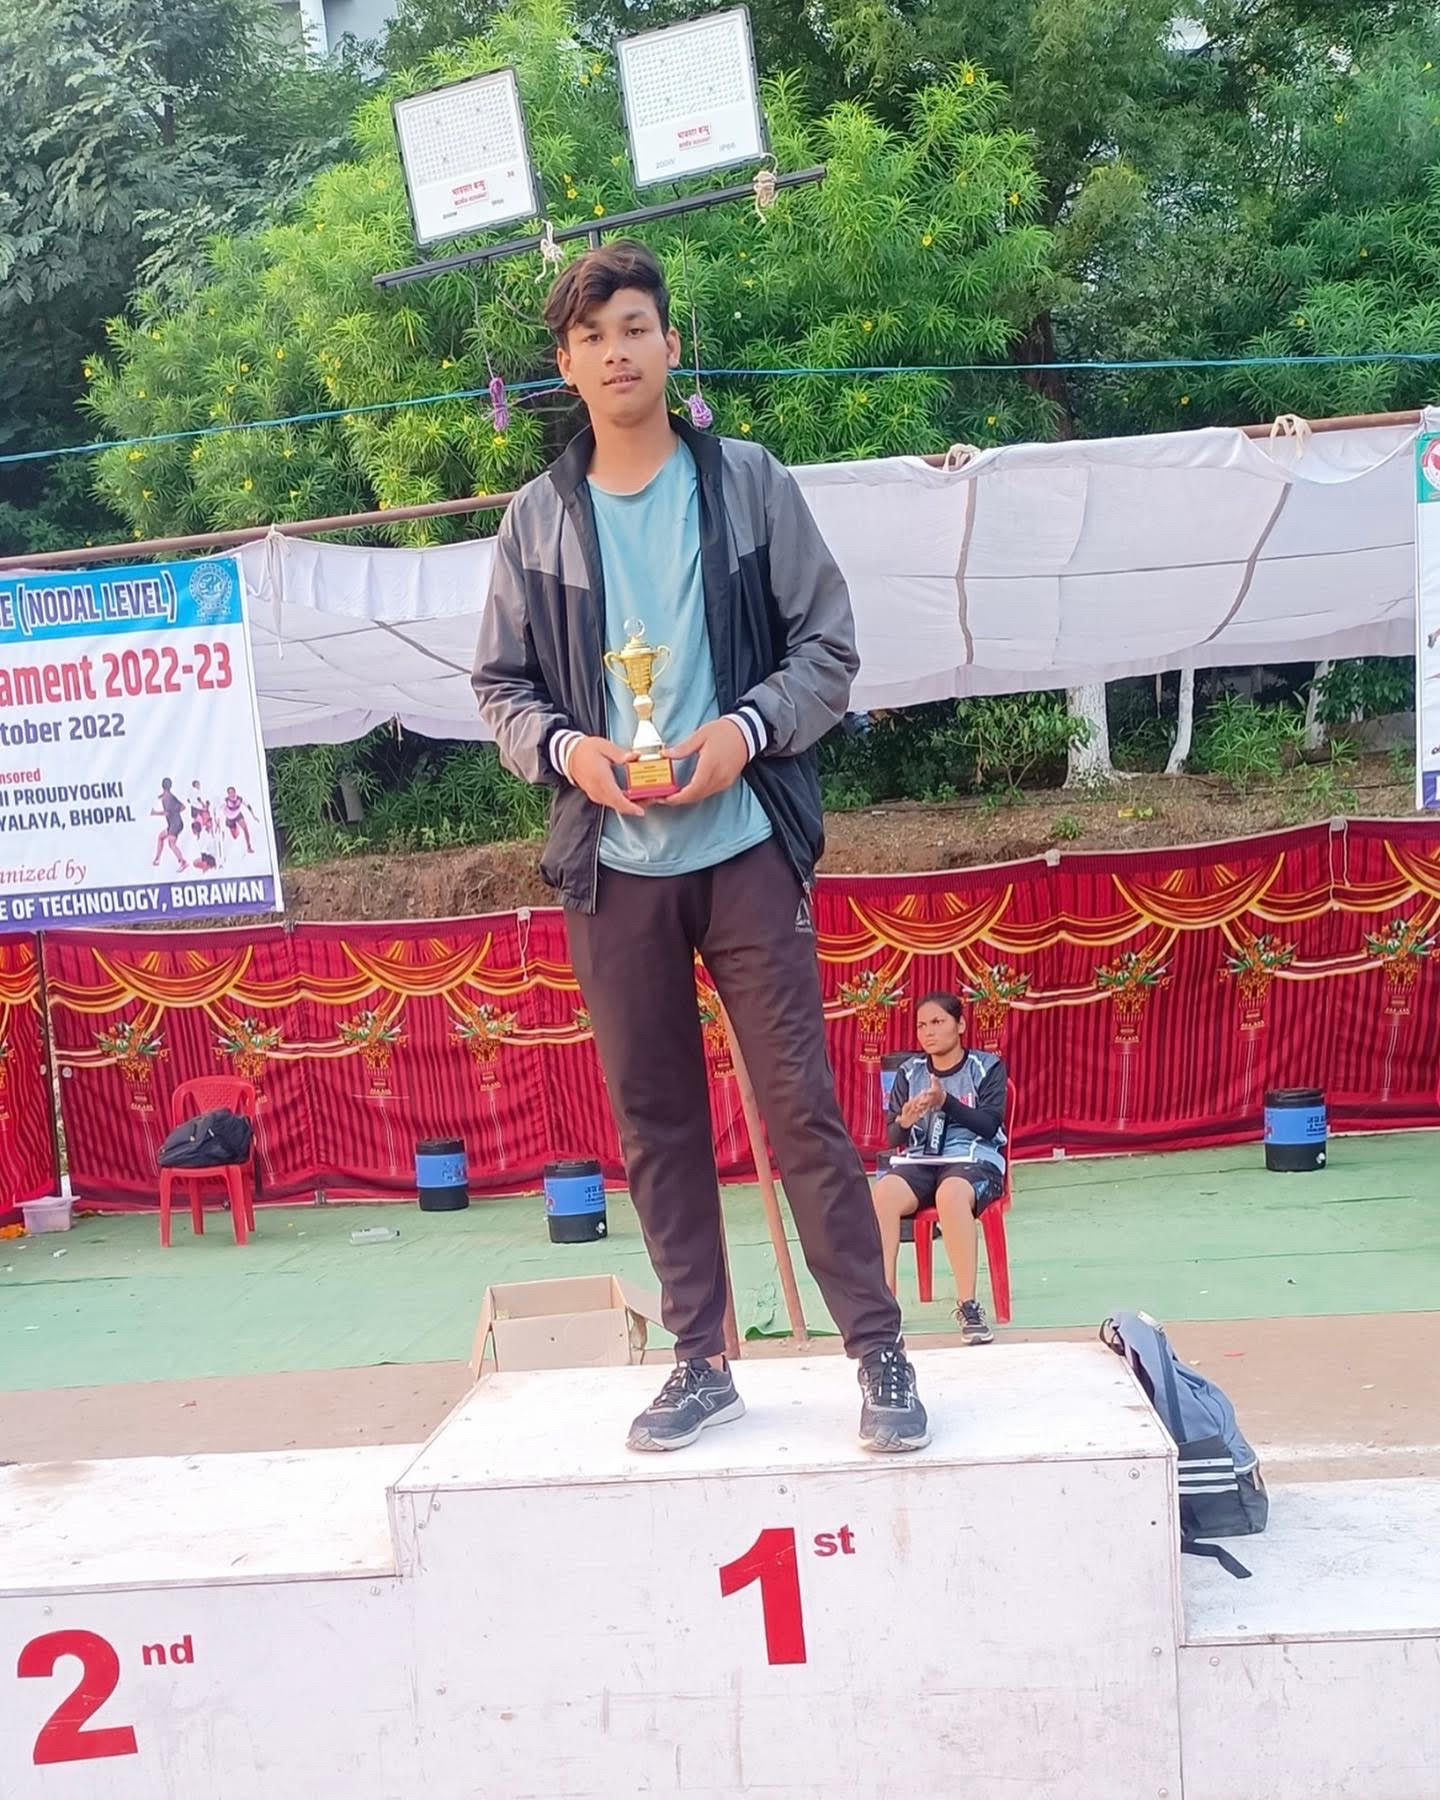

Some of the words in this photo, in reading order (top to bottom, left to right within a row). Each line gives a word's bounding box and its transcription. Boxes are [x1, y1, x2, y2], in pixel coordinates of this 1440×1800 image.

[17, 584, 101, 636] (NODAL
[101, 570, 177, 623] LEVEL)
[102, 642, 233, 698] 2022-23
[0, 719, 62, 746] tober
[68, 713, 125, 741] 2022
[14, 781, 124, 806] PROUDYOGIKI
[70, 805, 136, 827] BHOPAL
[65, 858, 87, 885] by
[12, 898, 35, 920] OF
[39, 887, 167, 918] TECHNOLOGY,
[171, 880, 264, 908] BORAWAN
